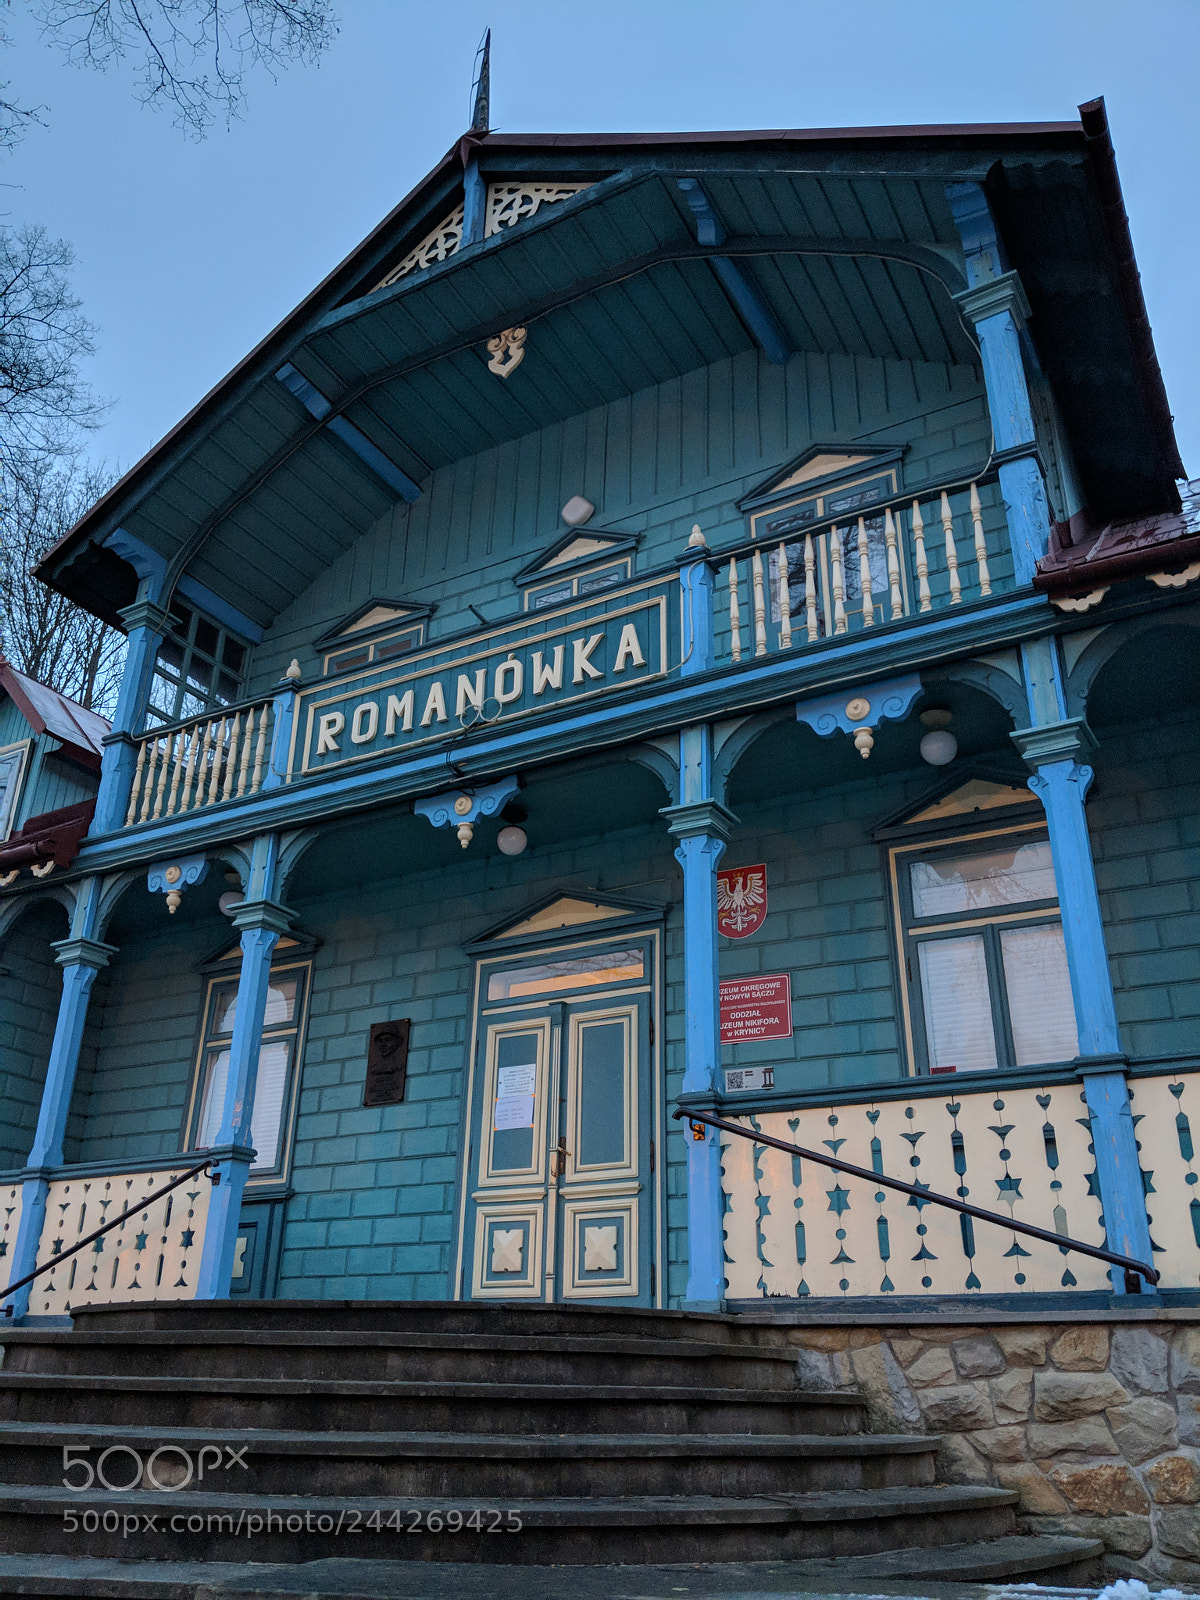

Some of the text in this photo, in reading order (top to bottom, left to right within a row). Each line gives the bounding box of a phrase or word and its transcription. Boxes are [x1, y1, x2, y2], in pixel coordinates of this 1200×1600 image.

[316, 622, 647, 756] ROMANÓWKA
[719, 981, 781, 995] ZEUM OKRĘGOWE
[725, 992, 750, 1001] NOWYM
[751, 990, 775, 998] SĄCZU
[730, 1009, 762, 1019] ODDZIAŁ
[745, 1016, 780, 1027] NIKIFORA
[734, 1026, 766, 1037] KRYNICY
